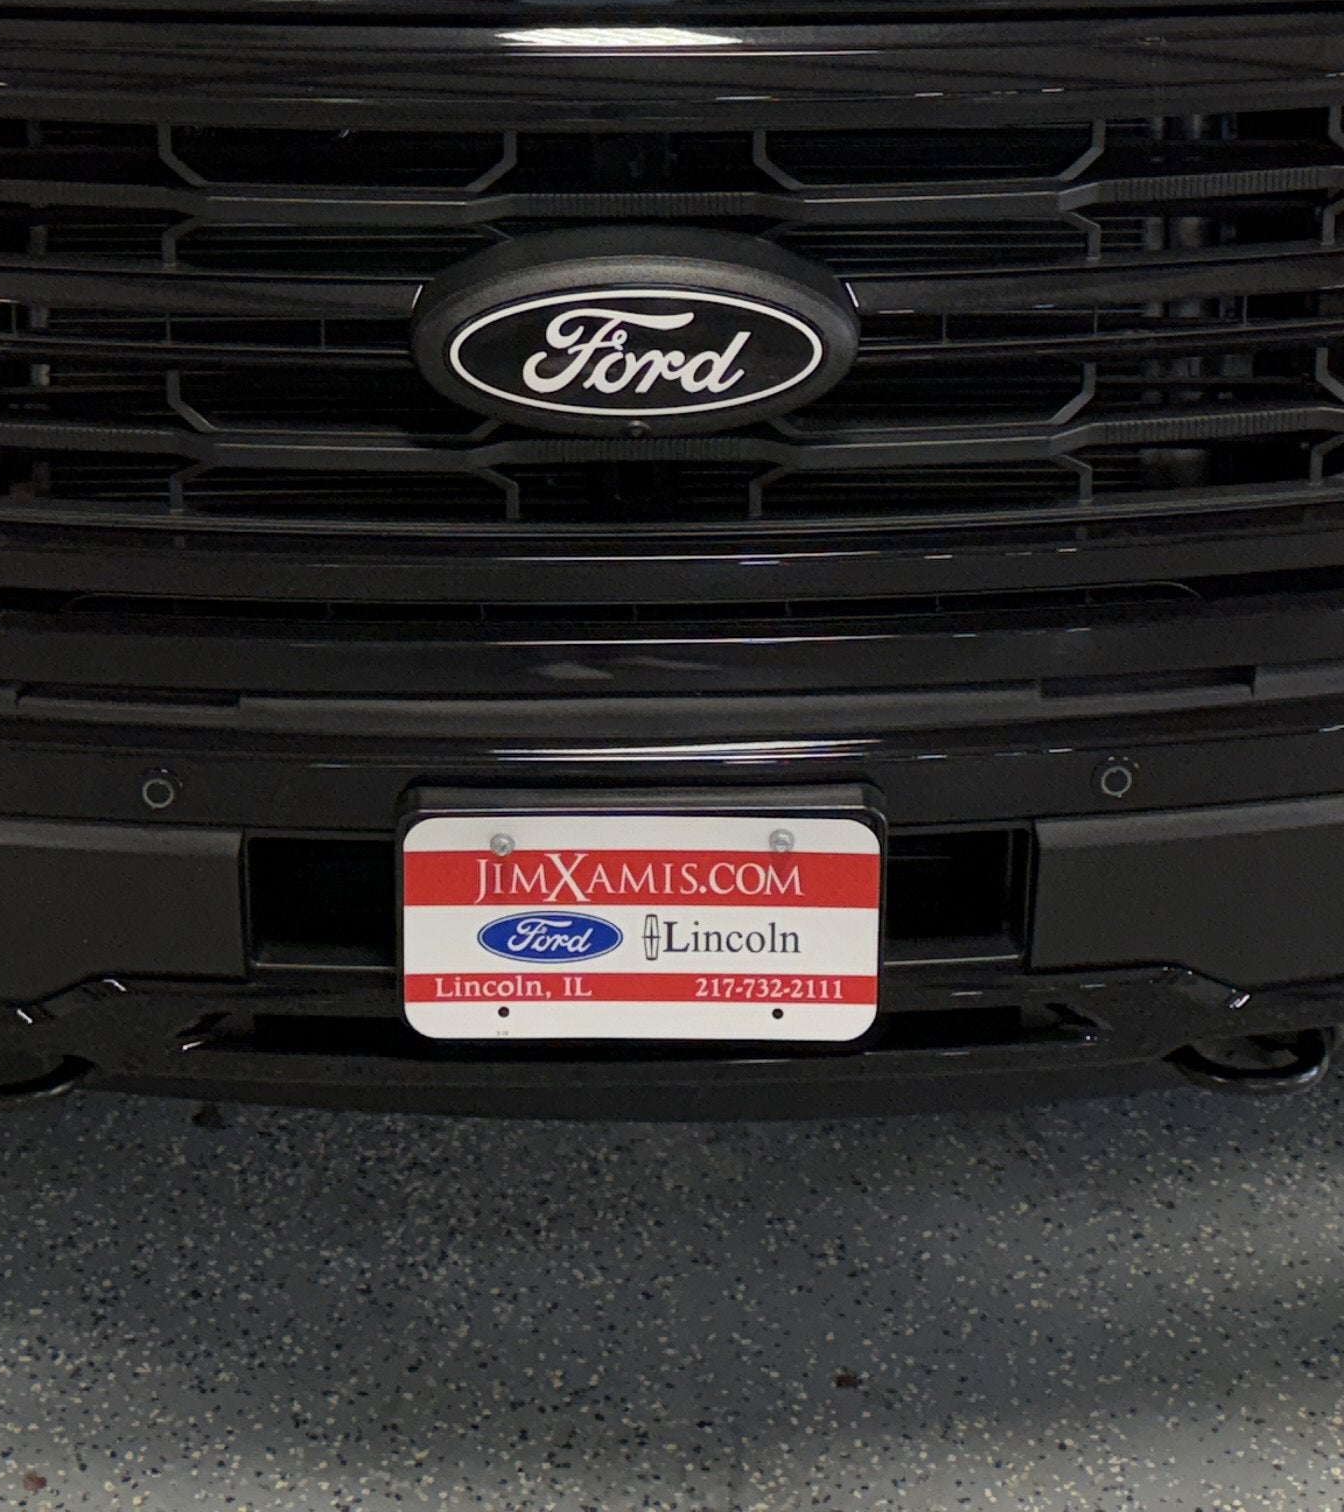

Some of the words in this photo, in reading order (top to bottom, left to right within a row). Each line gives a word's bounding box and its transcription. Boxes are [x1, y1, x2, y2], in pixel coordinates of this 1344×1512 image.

[522, 308, 751, 394] Ford
[508, 918, 592, 955] Ford
[663, 921, 801, 955] Lincoln
[435, 976, 553, 999] Lincoln,
[563, 977, 593, 998] IL
[695, 978, 844, 999] 217-732-2111
